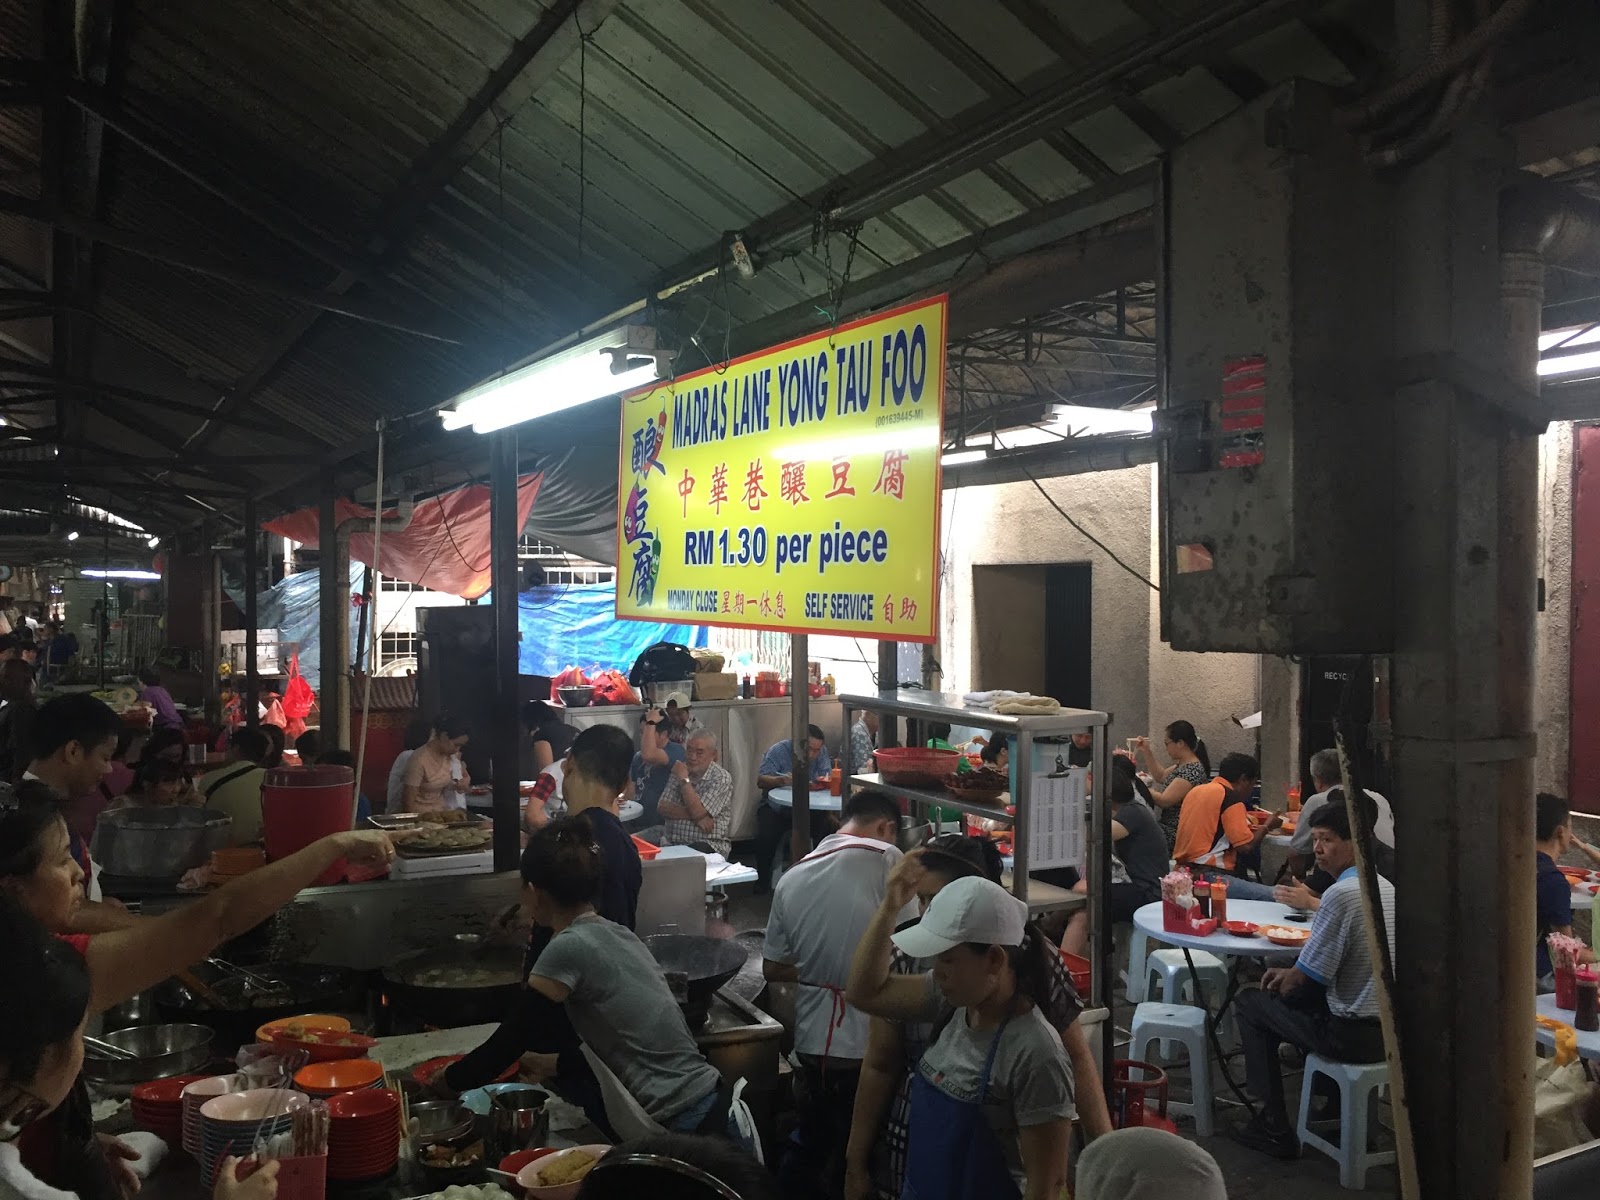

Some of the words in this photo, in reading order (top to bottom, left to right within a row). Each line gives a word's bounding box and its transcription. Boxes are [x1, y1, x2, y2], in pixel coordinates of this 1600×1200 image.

[672, 380, 728, 449] MADRAS
[732, 369, 771, 437] LANE
[778, 351, 829, 427] YONG
[836, 340, 873, 416] TAU
[880, 324, 927, 407] FOO
[684, 530, 714, 565] RM
[718, 526, 767, 565] 1.30
[775, 533, 812, 574] per
[819, 522, 888, 574] piece
[667, 589, 694, 611] MONDAY
[695, 590, 718, 612] CLOSE
[721, 590, 786, 619] 星期一休息
[804, 592, 828, 618] SELF
[830, 593, 874, 621] SERVICE
[881, 593, 918, 624] 自助
[1324, 671, 1347, 681] RECYC
